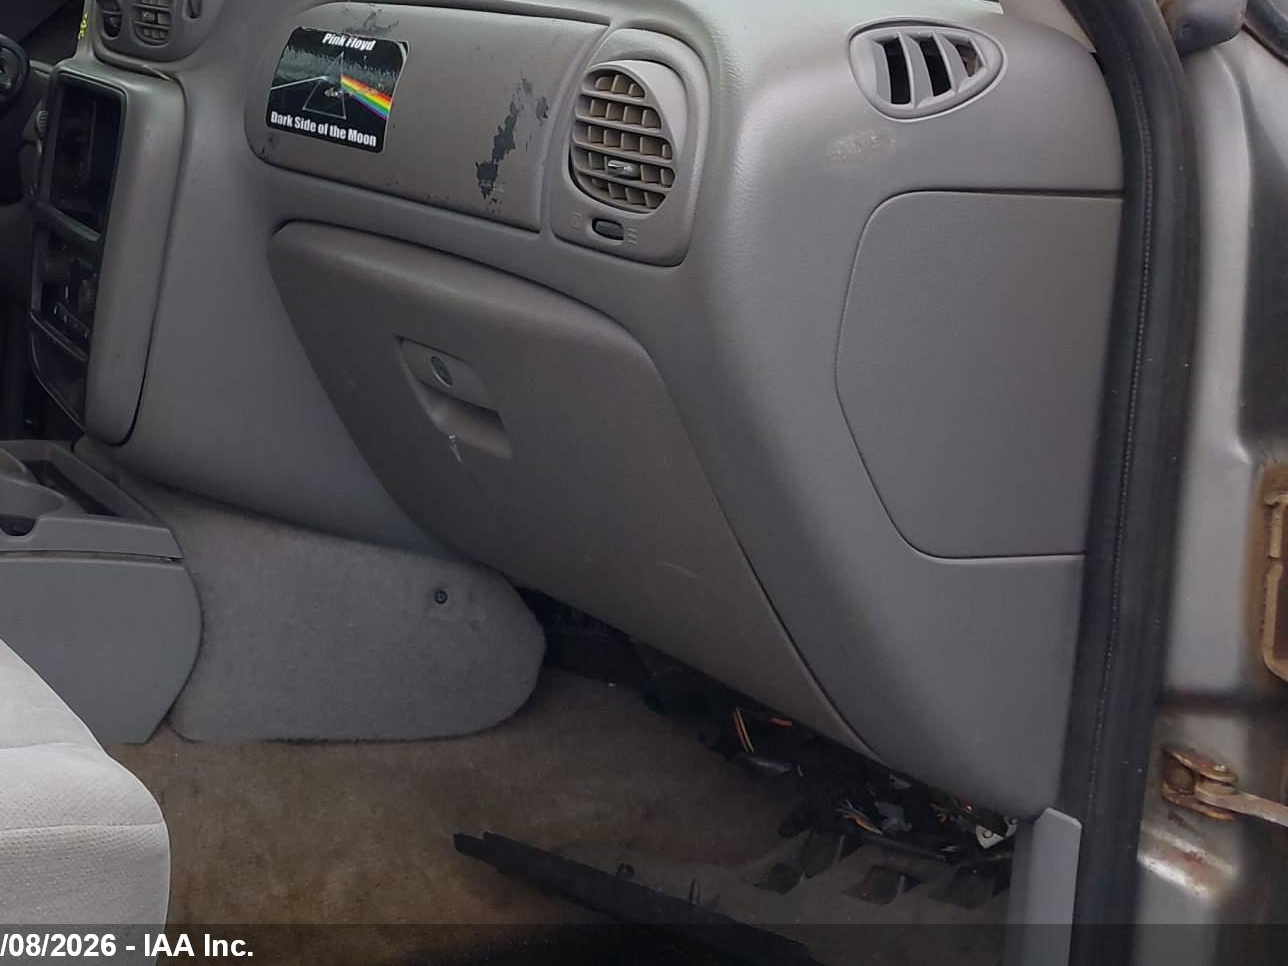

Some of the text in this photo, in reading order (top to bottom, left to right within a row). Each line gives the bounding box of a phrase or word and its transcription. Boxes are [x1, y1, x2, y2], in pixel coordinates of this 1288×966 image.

[322, 32, 377, 51] Pink Floyd
[270, 111, 376, 146] Dark Side of the Moon
